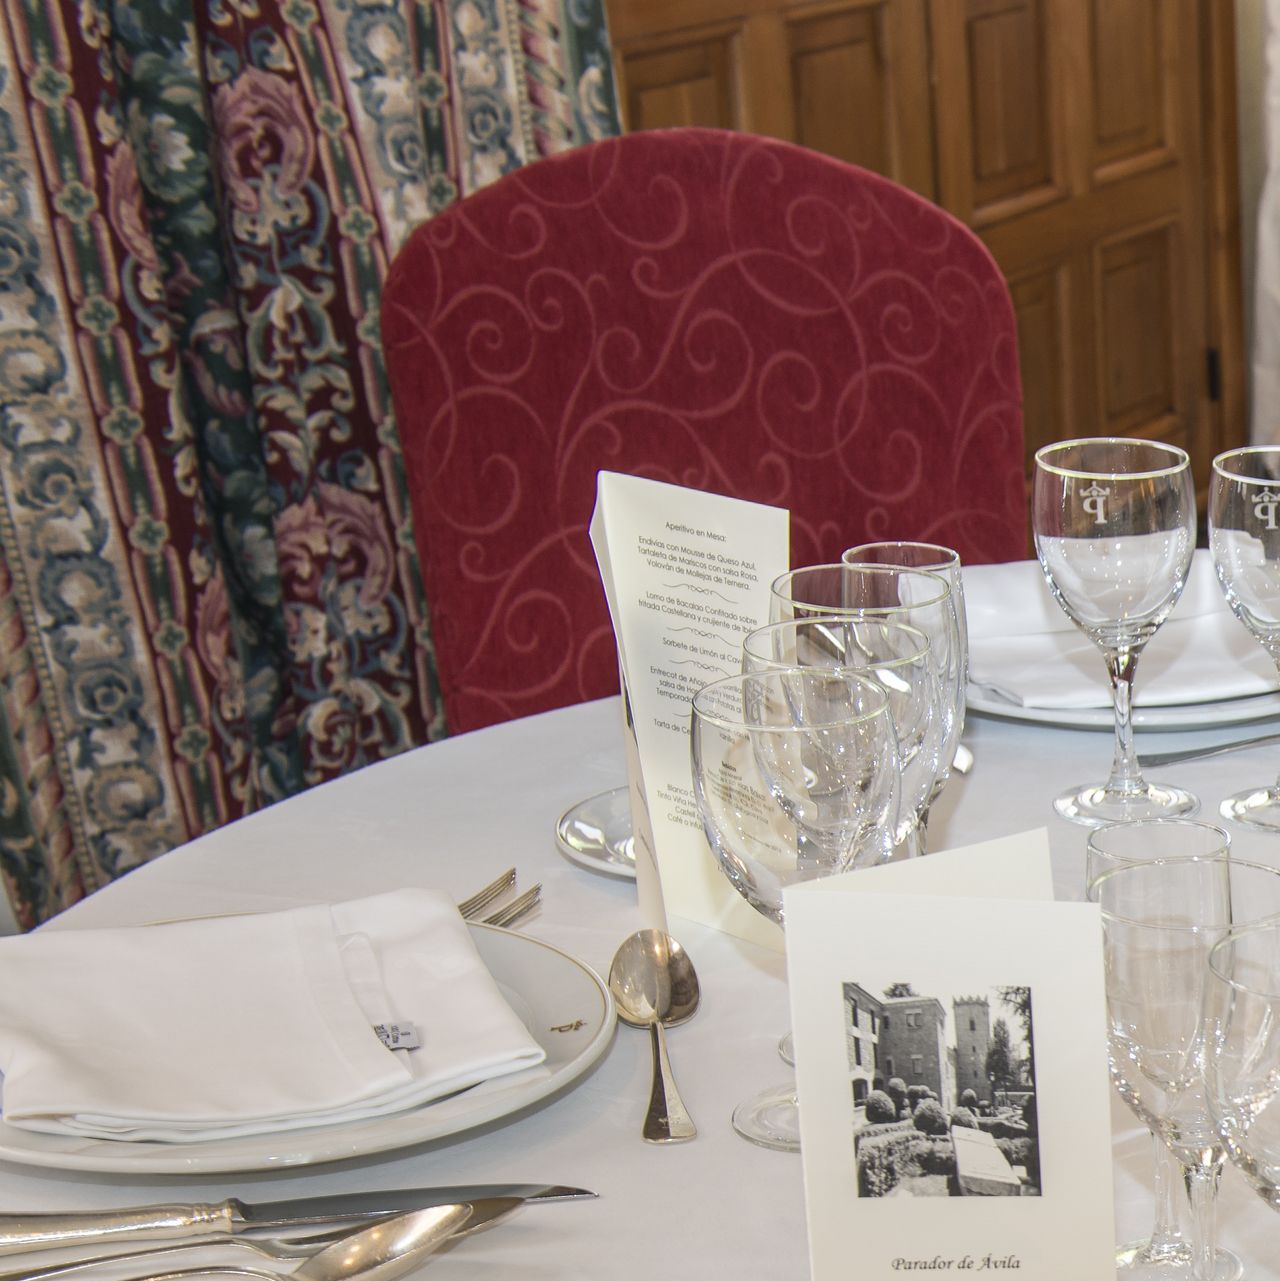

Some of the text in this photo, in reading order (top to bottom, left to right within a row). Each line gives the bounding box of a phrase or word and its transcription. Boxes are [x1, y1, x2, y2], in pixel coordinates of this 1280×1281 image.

[666, 522, 695, 535] Aperitivo
[706, 532, 726, 542] Mesa:
[638, 536, 665, 548] Endivias
[666, 543, 679, 552] con
[681, 546, 704, 558] Mousse
[717, 555, 739, 566] Queso
[638, 546, 667, 560] Tartaleta
[668, 553, 677, 562] de
[679, 556, 706, 569] Mariscos
[708, 564, 721, 572] con
[722, 568, 739, 577] salsa
[647, 559, 674, 571] Volován
[675, 566, 684, 574] de
[686, 568, 712, 582] Mollejas
[713, 576, 722, 584] de
[646, 591, 757, 625] Lomo de Bacalao Confitado sobre
[662, 606, 696, 620] Castellana
[702, 617, 730, 630] crujiente
[732, 624, 741, 632] de
[662, 638, 688, 650] Sorbete
[689, 645, 698, 654] de
[700, 648, 718, 659] Limón
[650, 666, 677, 680] Entrecot
[659, 679, 675, 689] salsa
[676, 683, 686, 692] de
[654, 718, 671, 730] Tarta
[657, 790, 672, 801] Tinto
[667, 814, 683, 824] Café
[892, 1253, 1021, 1271] Parador de Ávila
